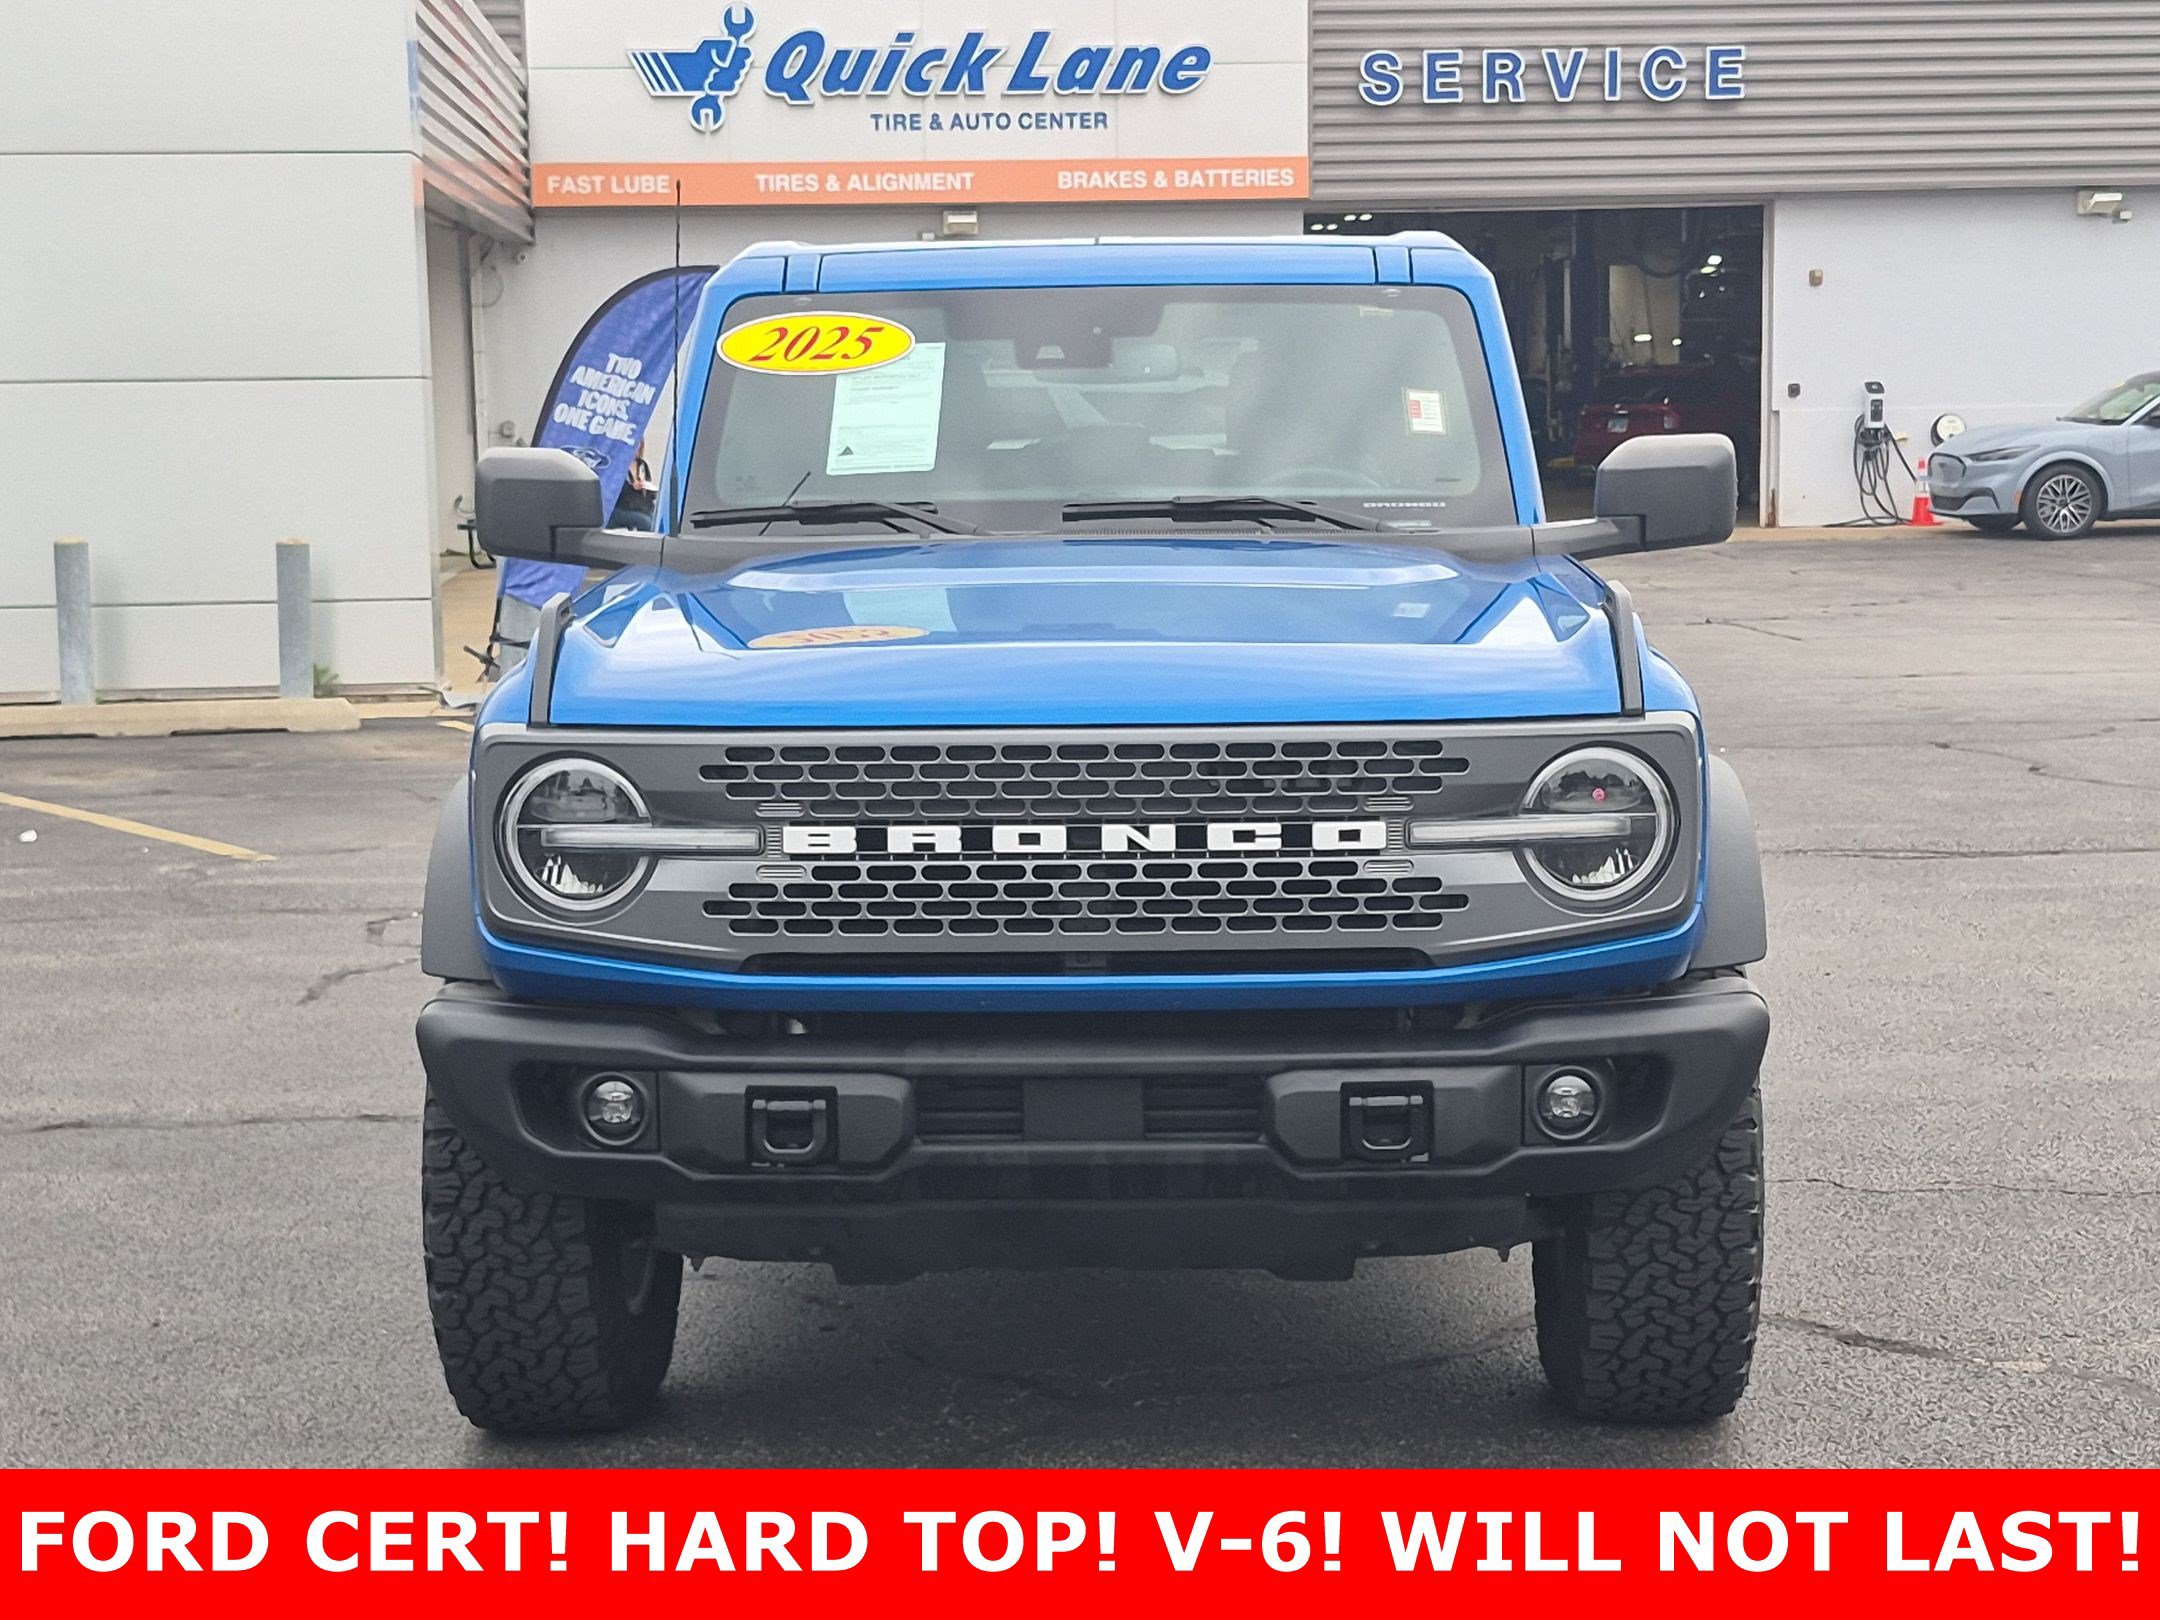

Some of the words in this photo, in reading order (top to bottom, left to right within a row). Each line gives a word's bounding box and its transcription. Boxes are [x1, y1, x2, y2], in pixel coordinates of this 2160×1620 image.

[762, 29, 1005, 105] Quick
[1004, 30, 1213, 95] Lane
[1359, 45, 1746, 106] SERVICE
[870, 113, 922, 131] TIRE
[928, 113, 944, 131] &
[949, 112, 1012, 131] AUTO
[1017, 111, 1109, 130] CENTER
[546, 175, 606, 195] FAST
[609, 174, 672, 195] LUBE
[754, 172, 821, 193] TIRES
[825, 172, 842, 193] &
[845, 170, 975, 192] ALIGNMENT
[1056, 169, 1149, 190] BRAKES
[1152, 169, 1170, 190] &
[1174, 167, 1296, 189] BATTERIES
[747, 326, 885, 362] 2025
[605, 352, 643, 380] TWO
[569, 365, 656, 405] AMERICAN
[554, 402, 593, 432] ONE
[781, 822, 1388, 855] BRONCO
